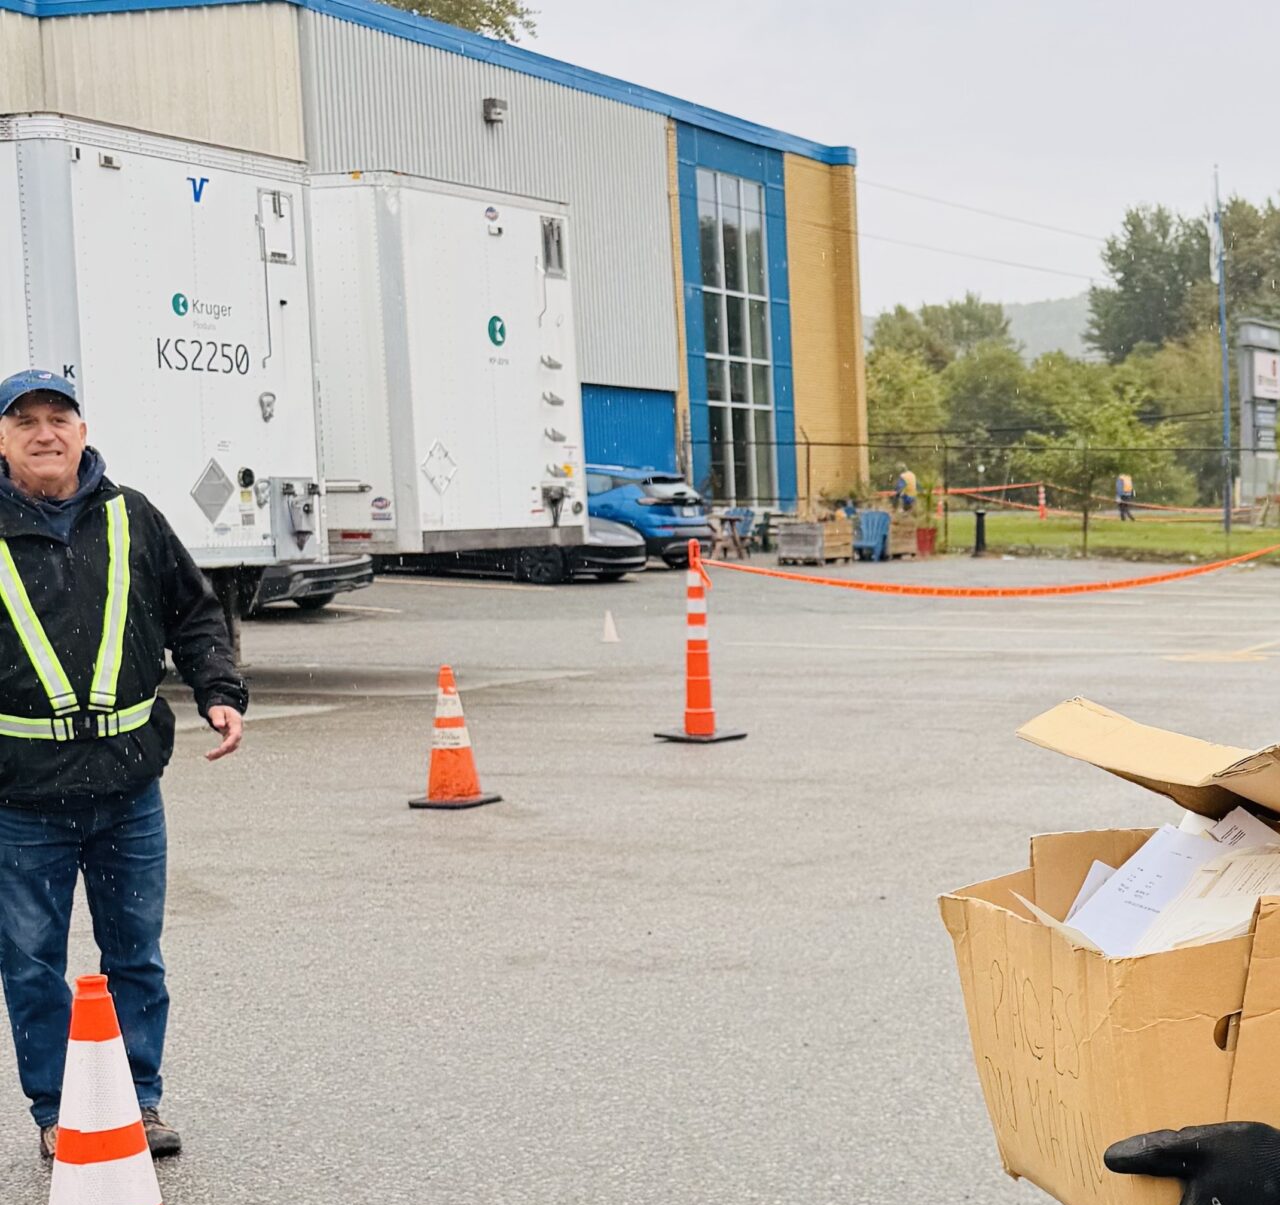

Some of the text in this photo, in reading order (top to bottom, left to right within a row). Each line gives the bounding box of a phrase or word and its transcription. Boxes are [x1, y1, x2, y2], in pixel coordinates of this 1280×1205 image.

[192, 299, 232, 320] Kruger
[157, 337, 249, 375] KS2250
[63, 364, 75, 378] K
